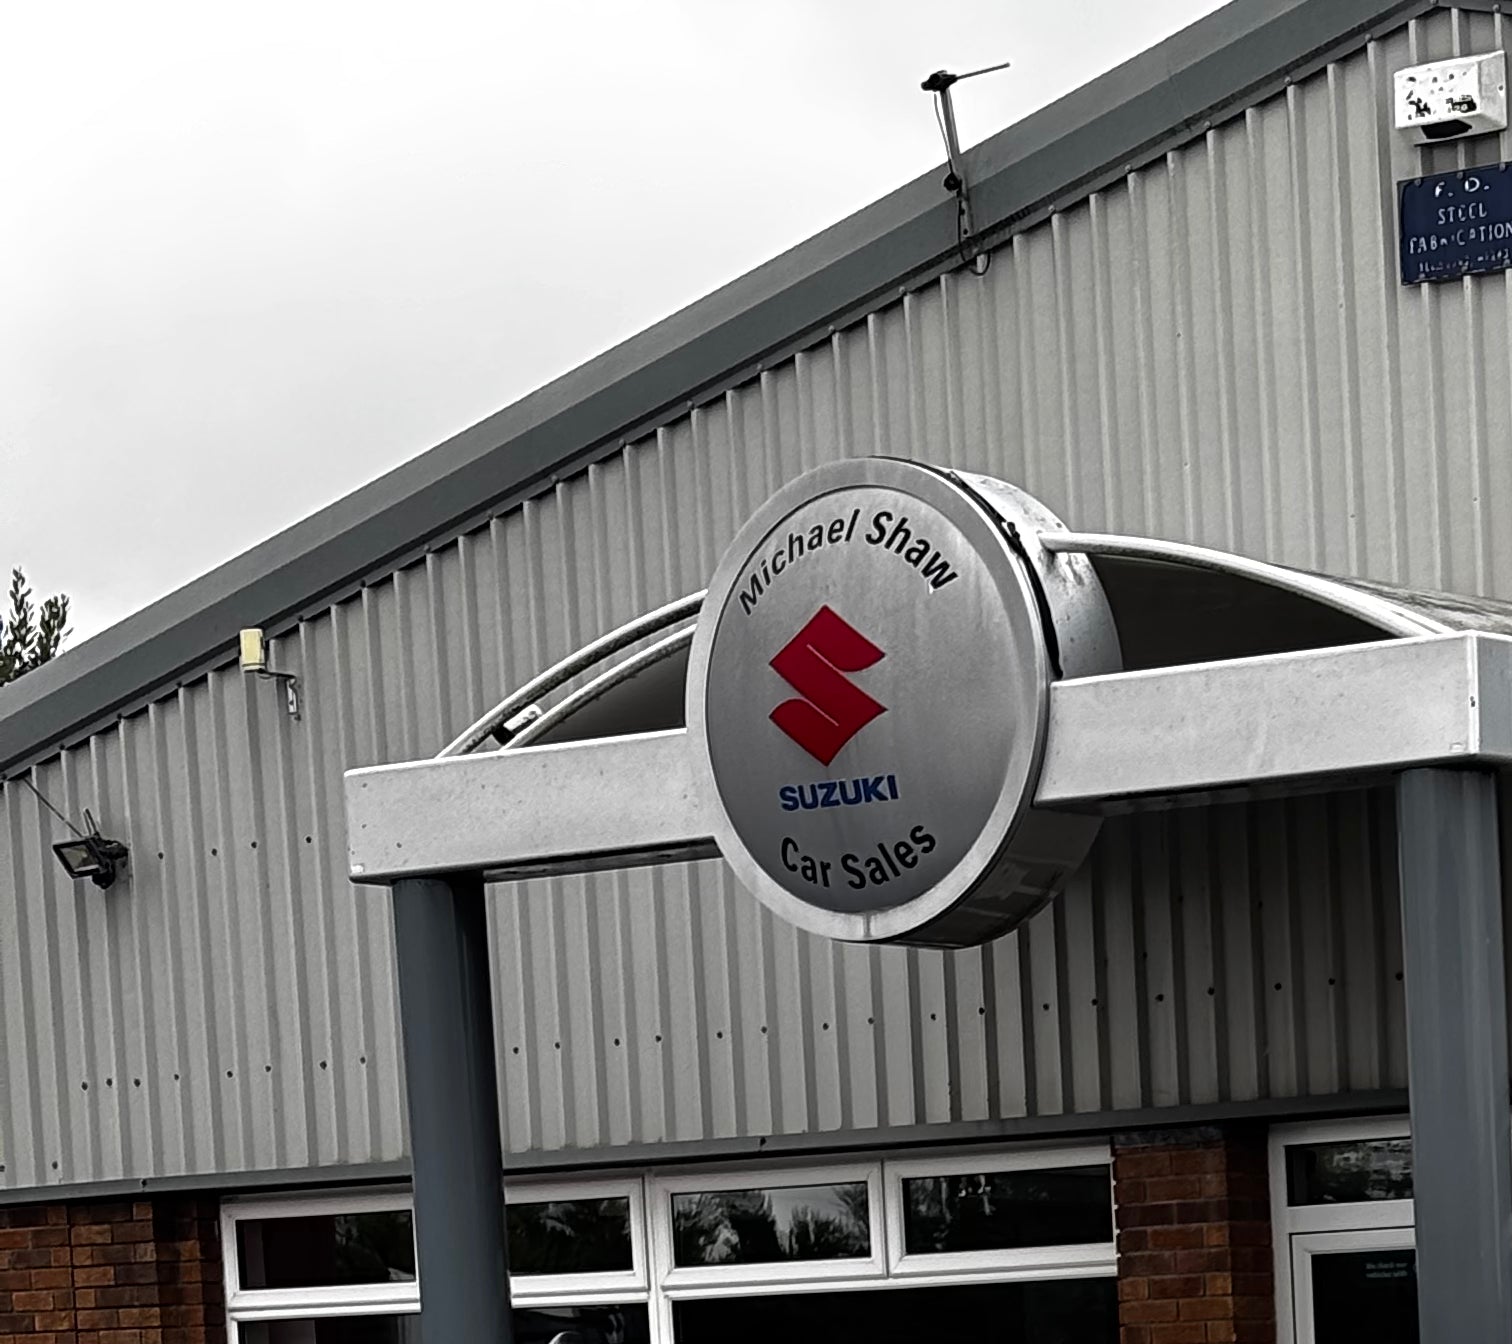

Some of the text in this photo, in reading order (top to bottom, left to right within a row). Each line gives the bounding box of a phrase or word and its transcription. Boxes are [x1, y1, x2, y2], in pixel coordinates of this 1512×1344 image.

[1437, 202, 1488, 225] STEEL
[736, 508, 959, 616] Michael Shaw
[778, 774, 899, 812] SUZUKI
[780, 823, 938, 890] Car Sales
